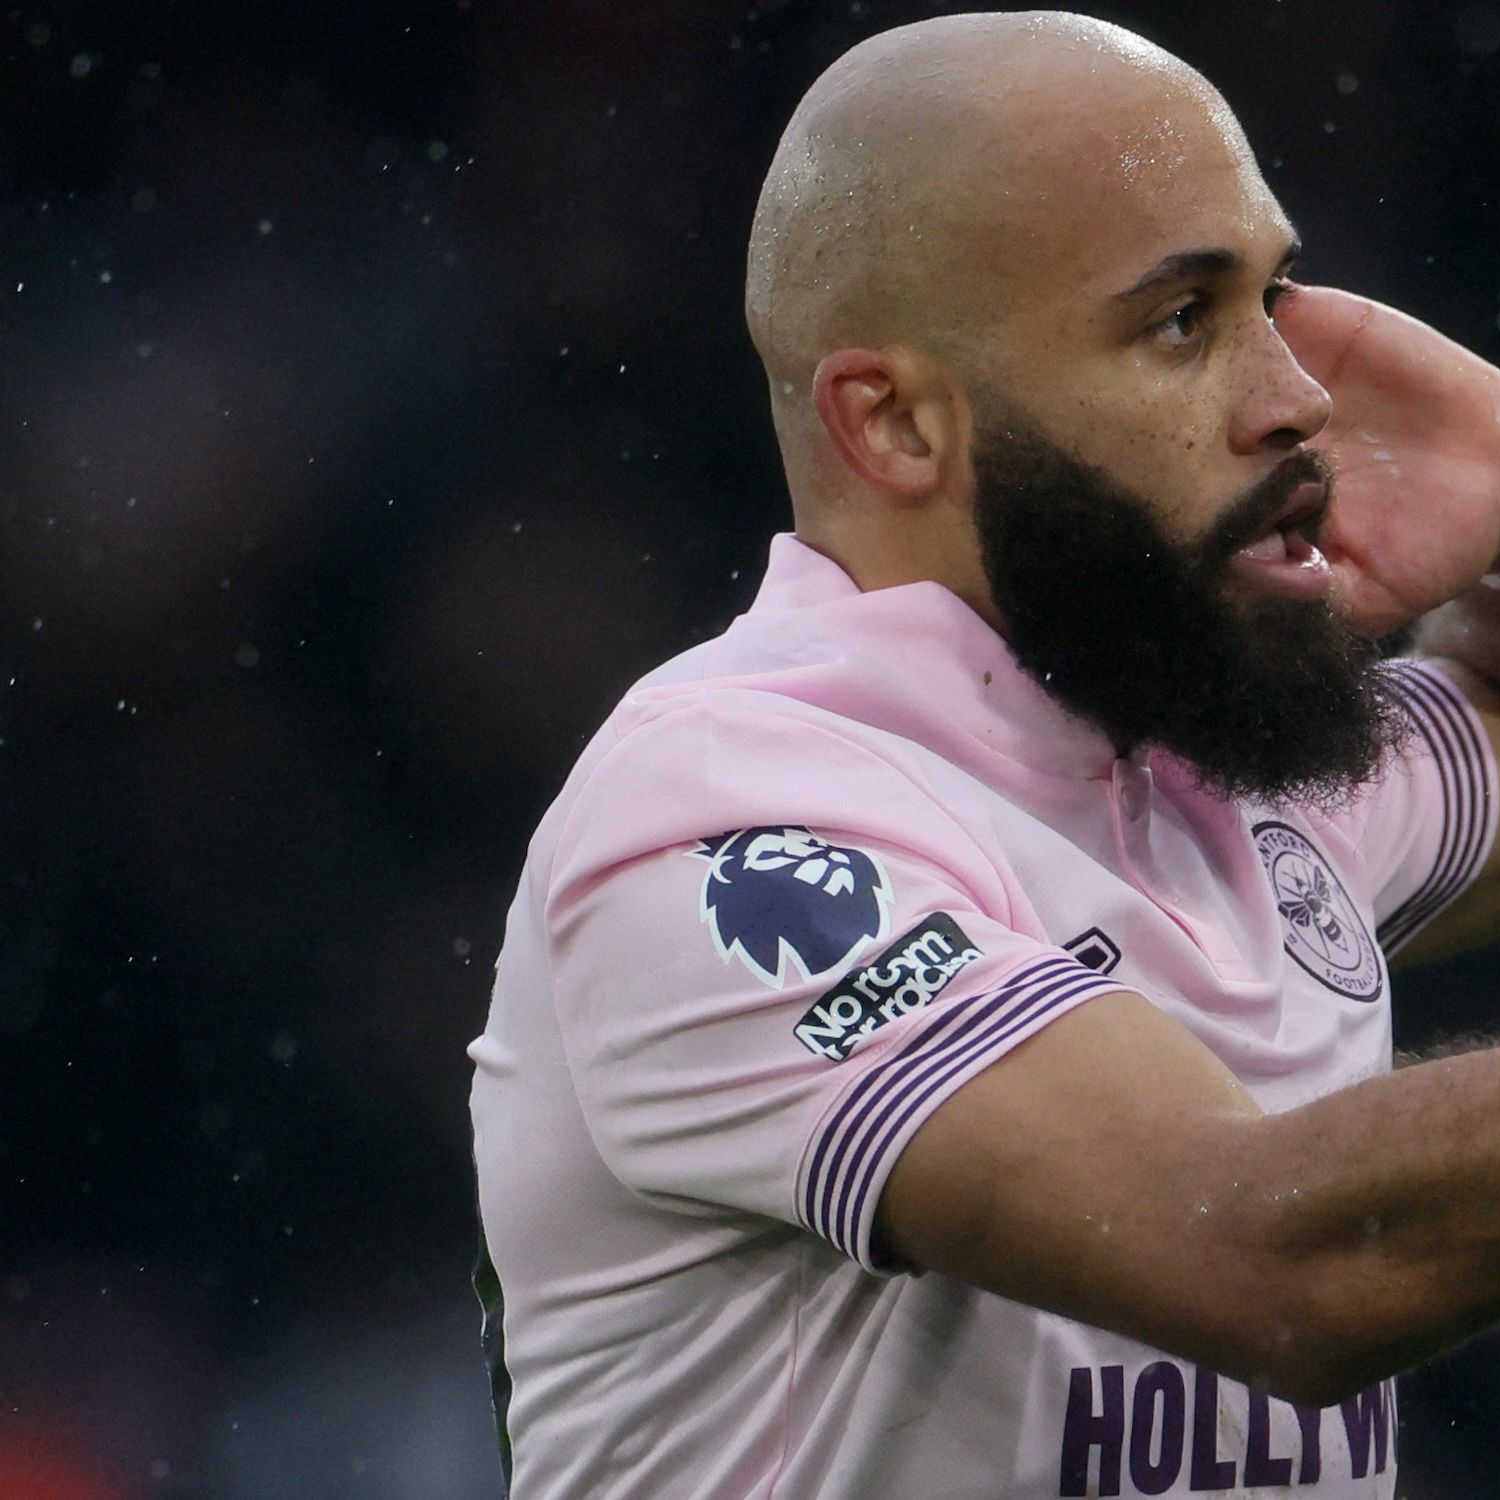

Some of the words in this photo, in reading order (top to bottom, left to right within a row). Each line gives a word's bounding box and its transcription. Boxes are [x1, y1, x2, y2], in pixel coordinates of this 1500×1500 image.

[795, 995, 863, 1055] No
[852, 930, 953, 1002] room
[1059, 1361, 1398, 1498] HOLLYW
